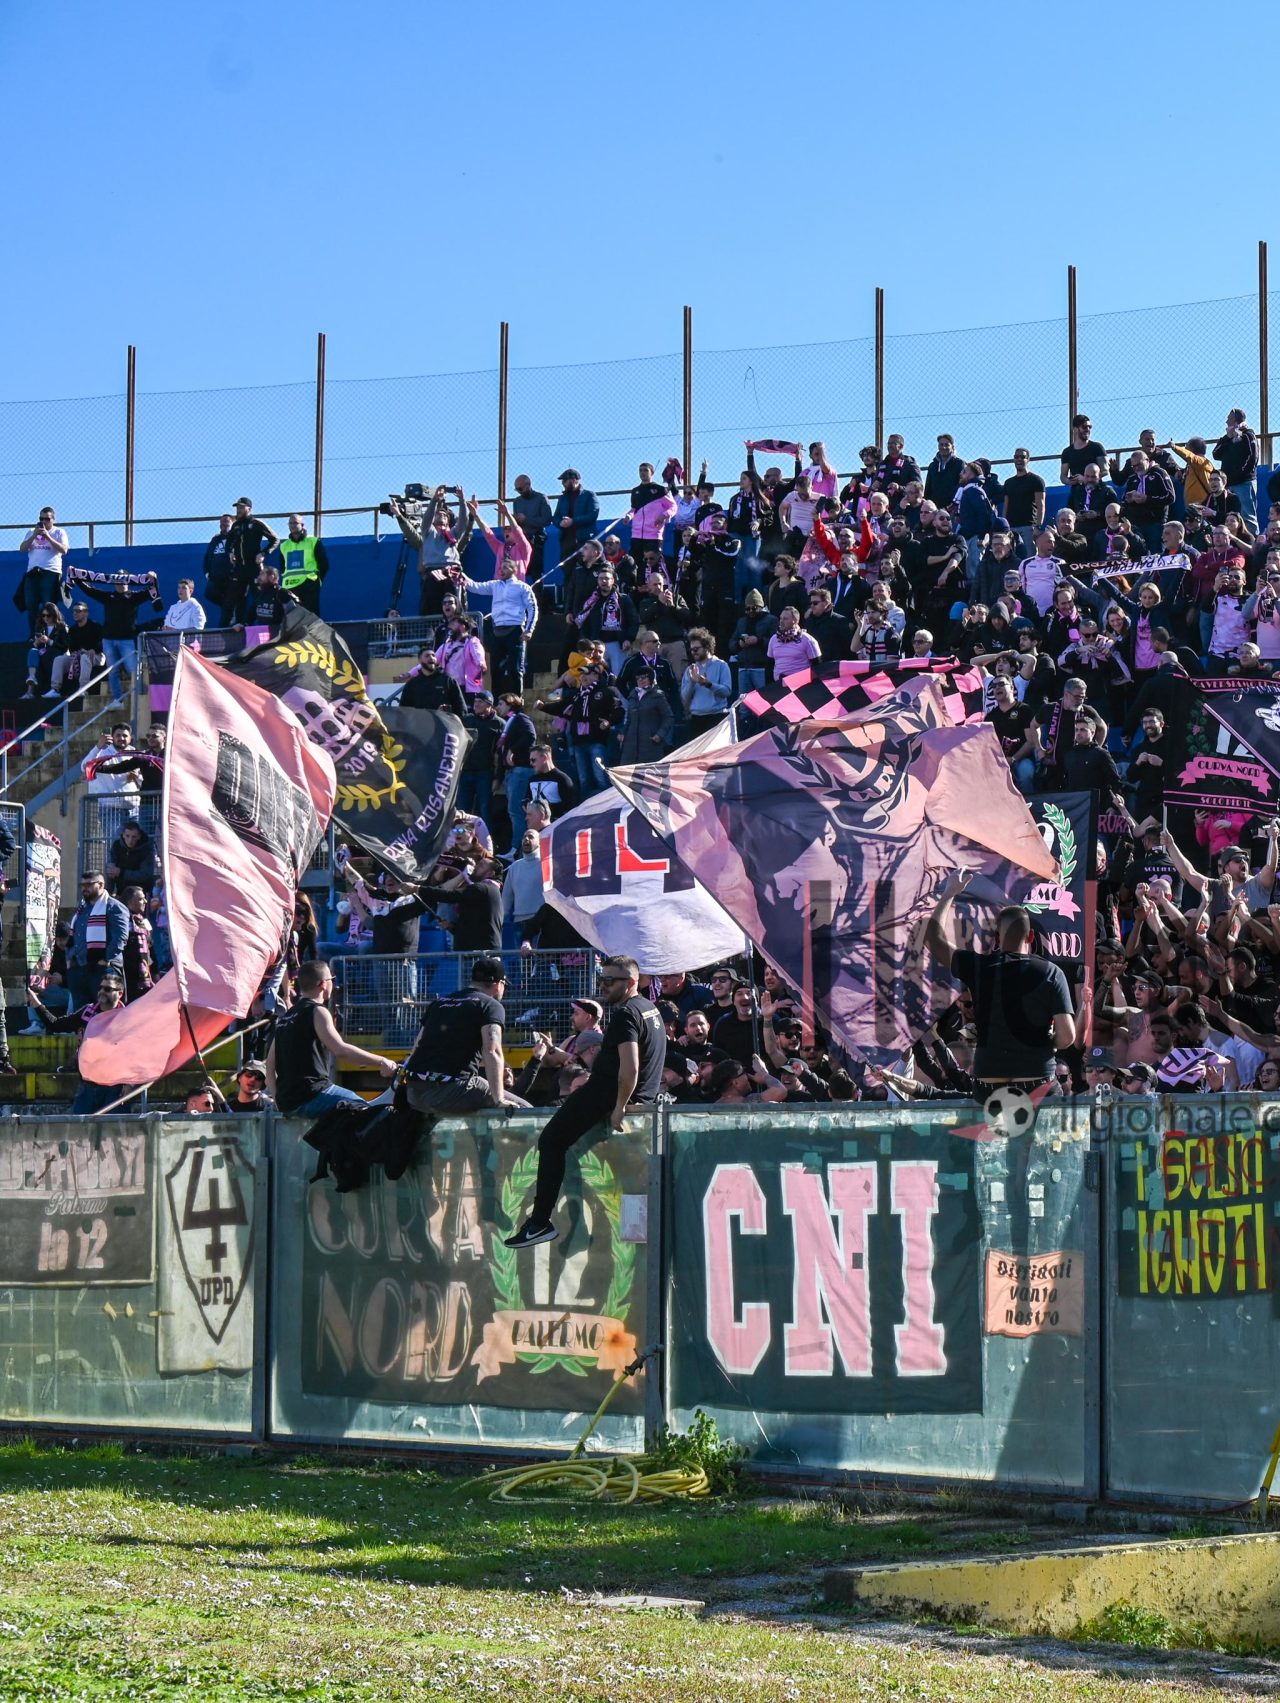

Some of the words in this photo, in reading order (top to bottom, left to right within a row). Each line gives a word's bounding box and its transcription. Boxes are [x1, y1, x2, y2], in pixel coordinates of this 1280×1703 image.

[344, 740, 379, 777] 2019
[1197, 760, 1233, 773] CURVA
[1236, 765, 1261, 778] NORD
[414, 732, 460, 834] ROSANERO
[45, 1191, 108, 1216] Palermo
[307, 1157, 485, 1264] CURVA
[76, 1218, 108, 1269] 12
[525, 1196, 596, 1307] 12
[1137, 1203, 1267, 1294] IGNOTI
[702, 1160, 947, 1377] CNI
[200, 1276, 234, 1306] UPD
[1009, 1286, 1058, 1303] vanto
[317, 1272, 473, 1384] NORD
[512, 1318, 605, 1351] PALERMO
[1005, 1309, 1060, 1326] nostro
